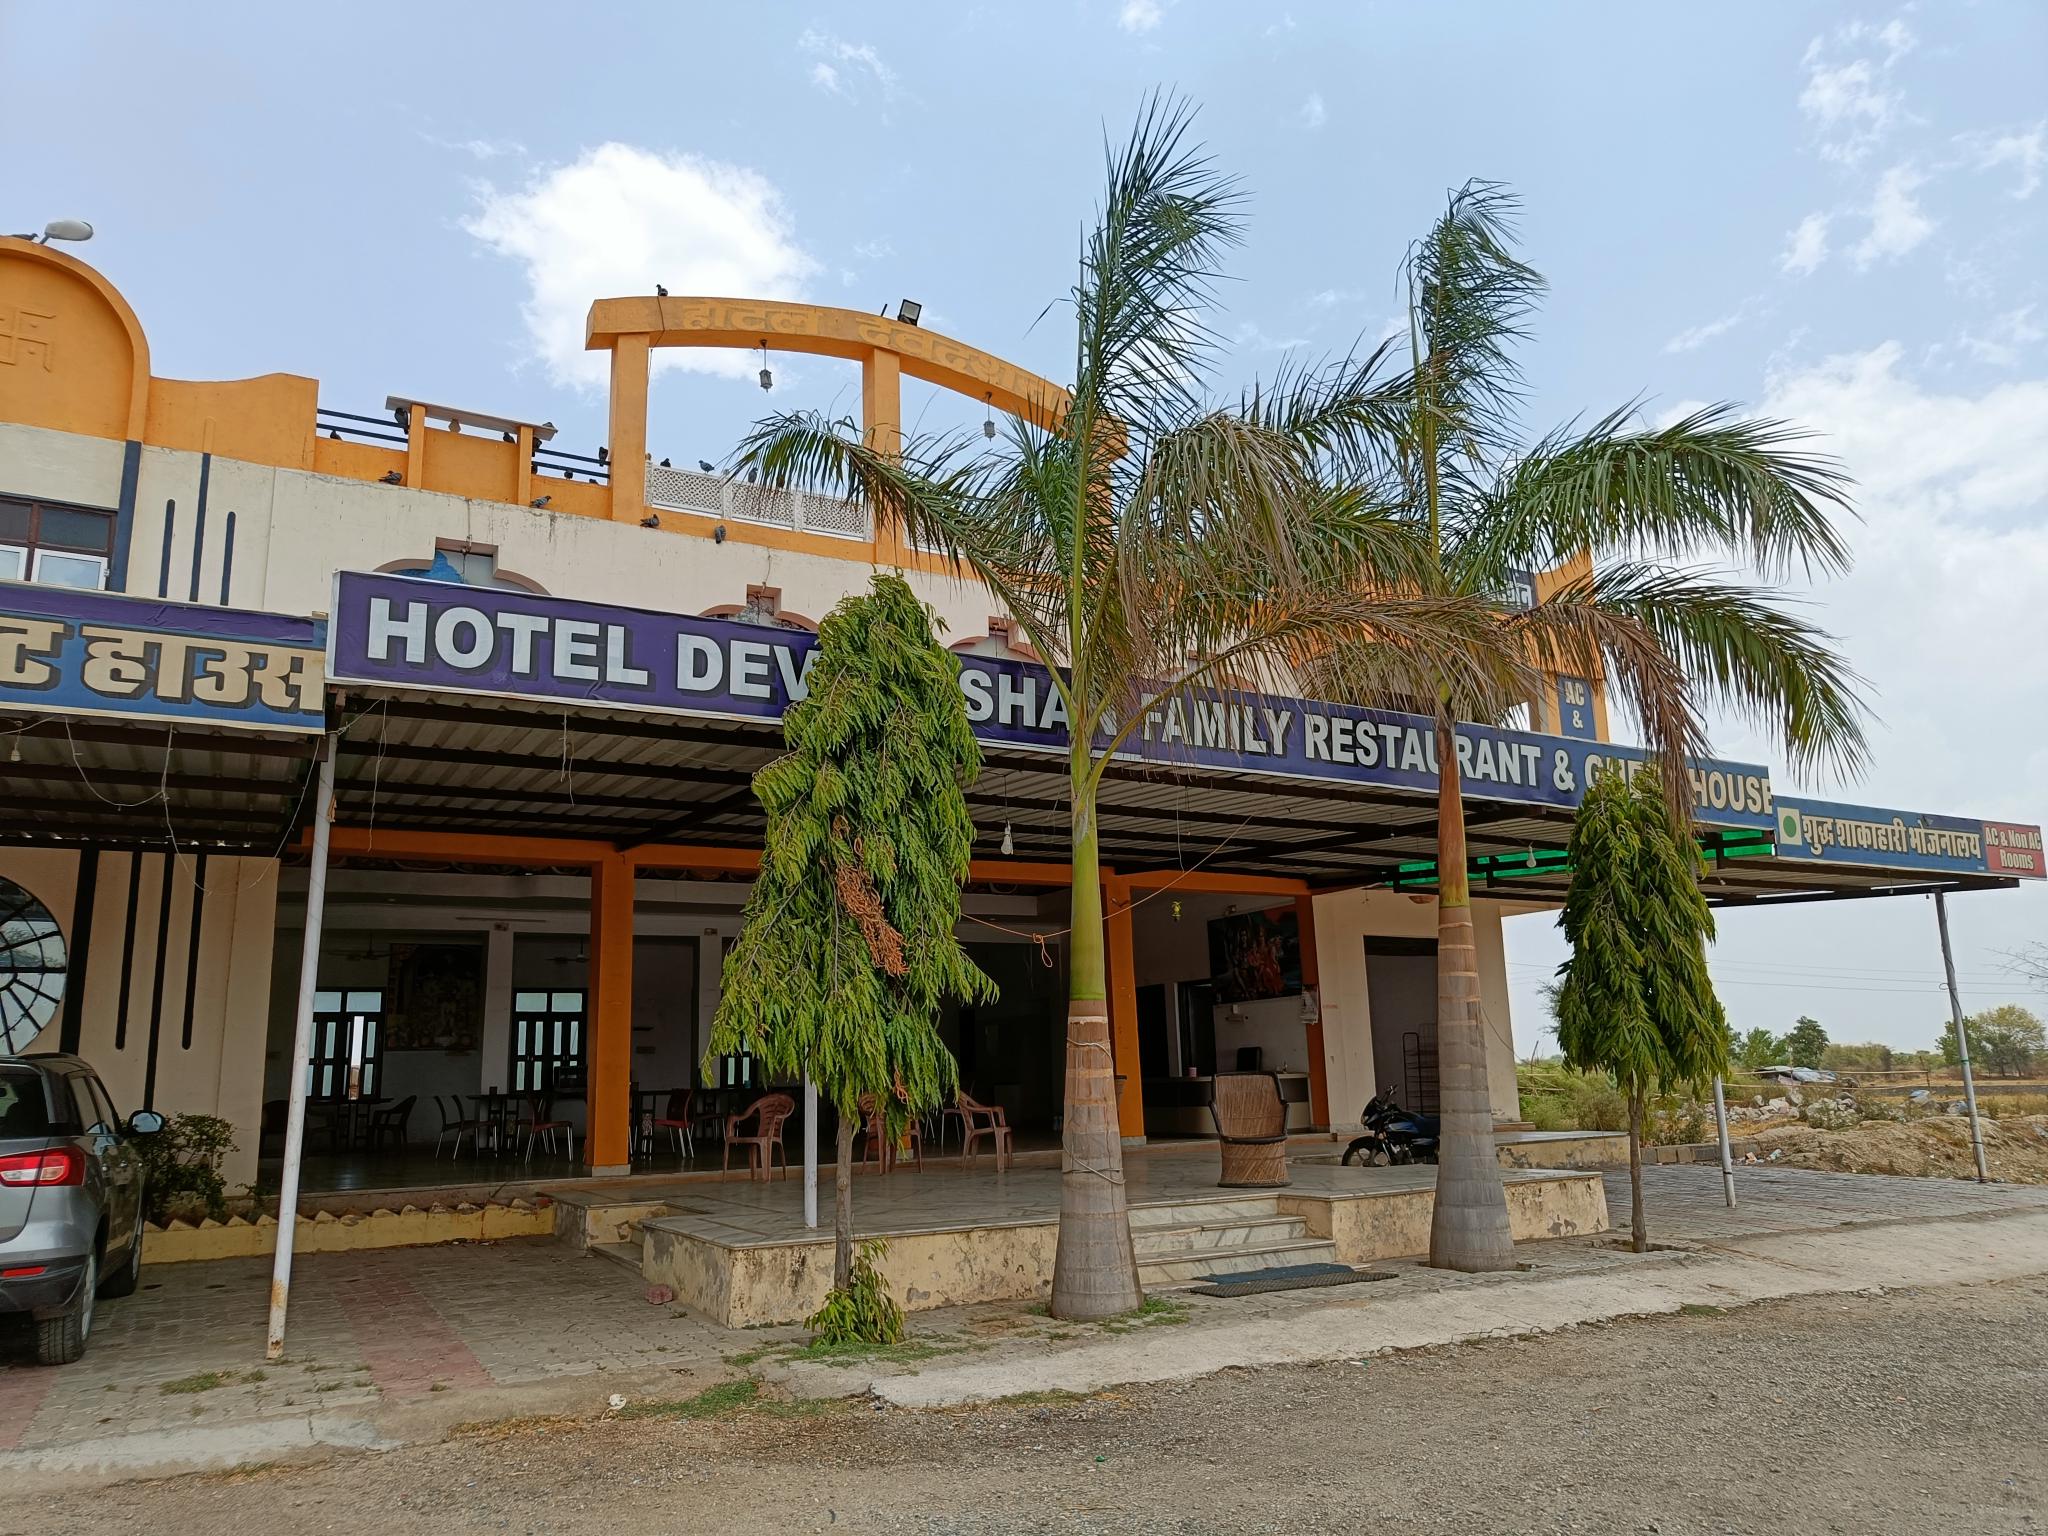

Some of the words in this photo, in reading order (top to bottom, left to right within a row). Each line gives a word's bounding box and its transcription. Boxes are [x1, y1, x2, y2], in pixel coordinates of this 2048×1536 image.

[81, 623, 325, 711] हाउस
[367, 597, 649, 687] HOTEL
[1141, 692, 1292, 756] FAMILY
[1553, 749, 1576, 792] &
[1688, 767, 1772, 815] HOUSE
[1564, 681, 1585, 706] AC
[1572, 710, 1583, 729] &
[1835, 817, 1908, 853] शाकाहारी
[1909, 820, 1982, 859] भोजनालय
[1985, 827, 1999, 846] AC
[2000, 831, 2009, 847] &
[2009, 830, 2028, 848] Non
[2028, 832, 2041, 850] AC
[2000, 849, 2034, 870] Rooms
